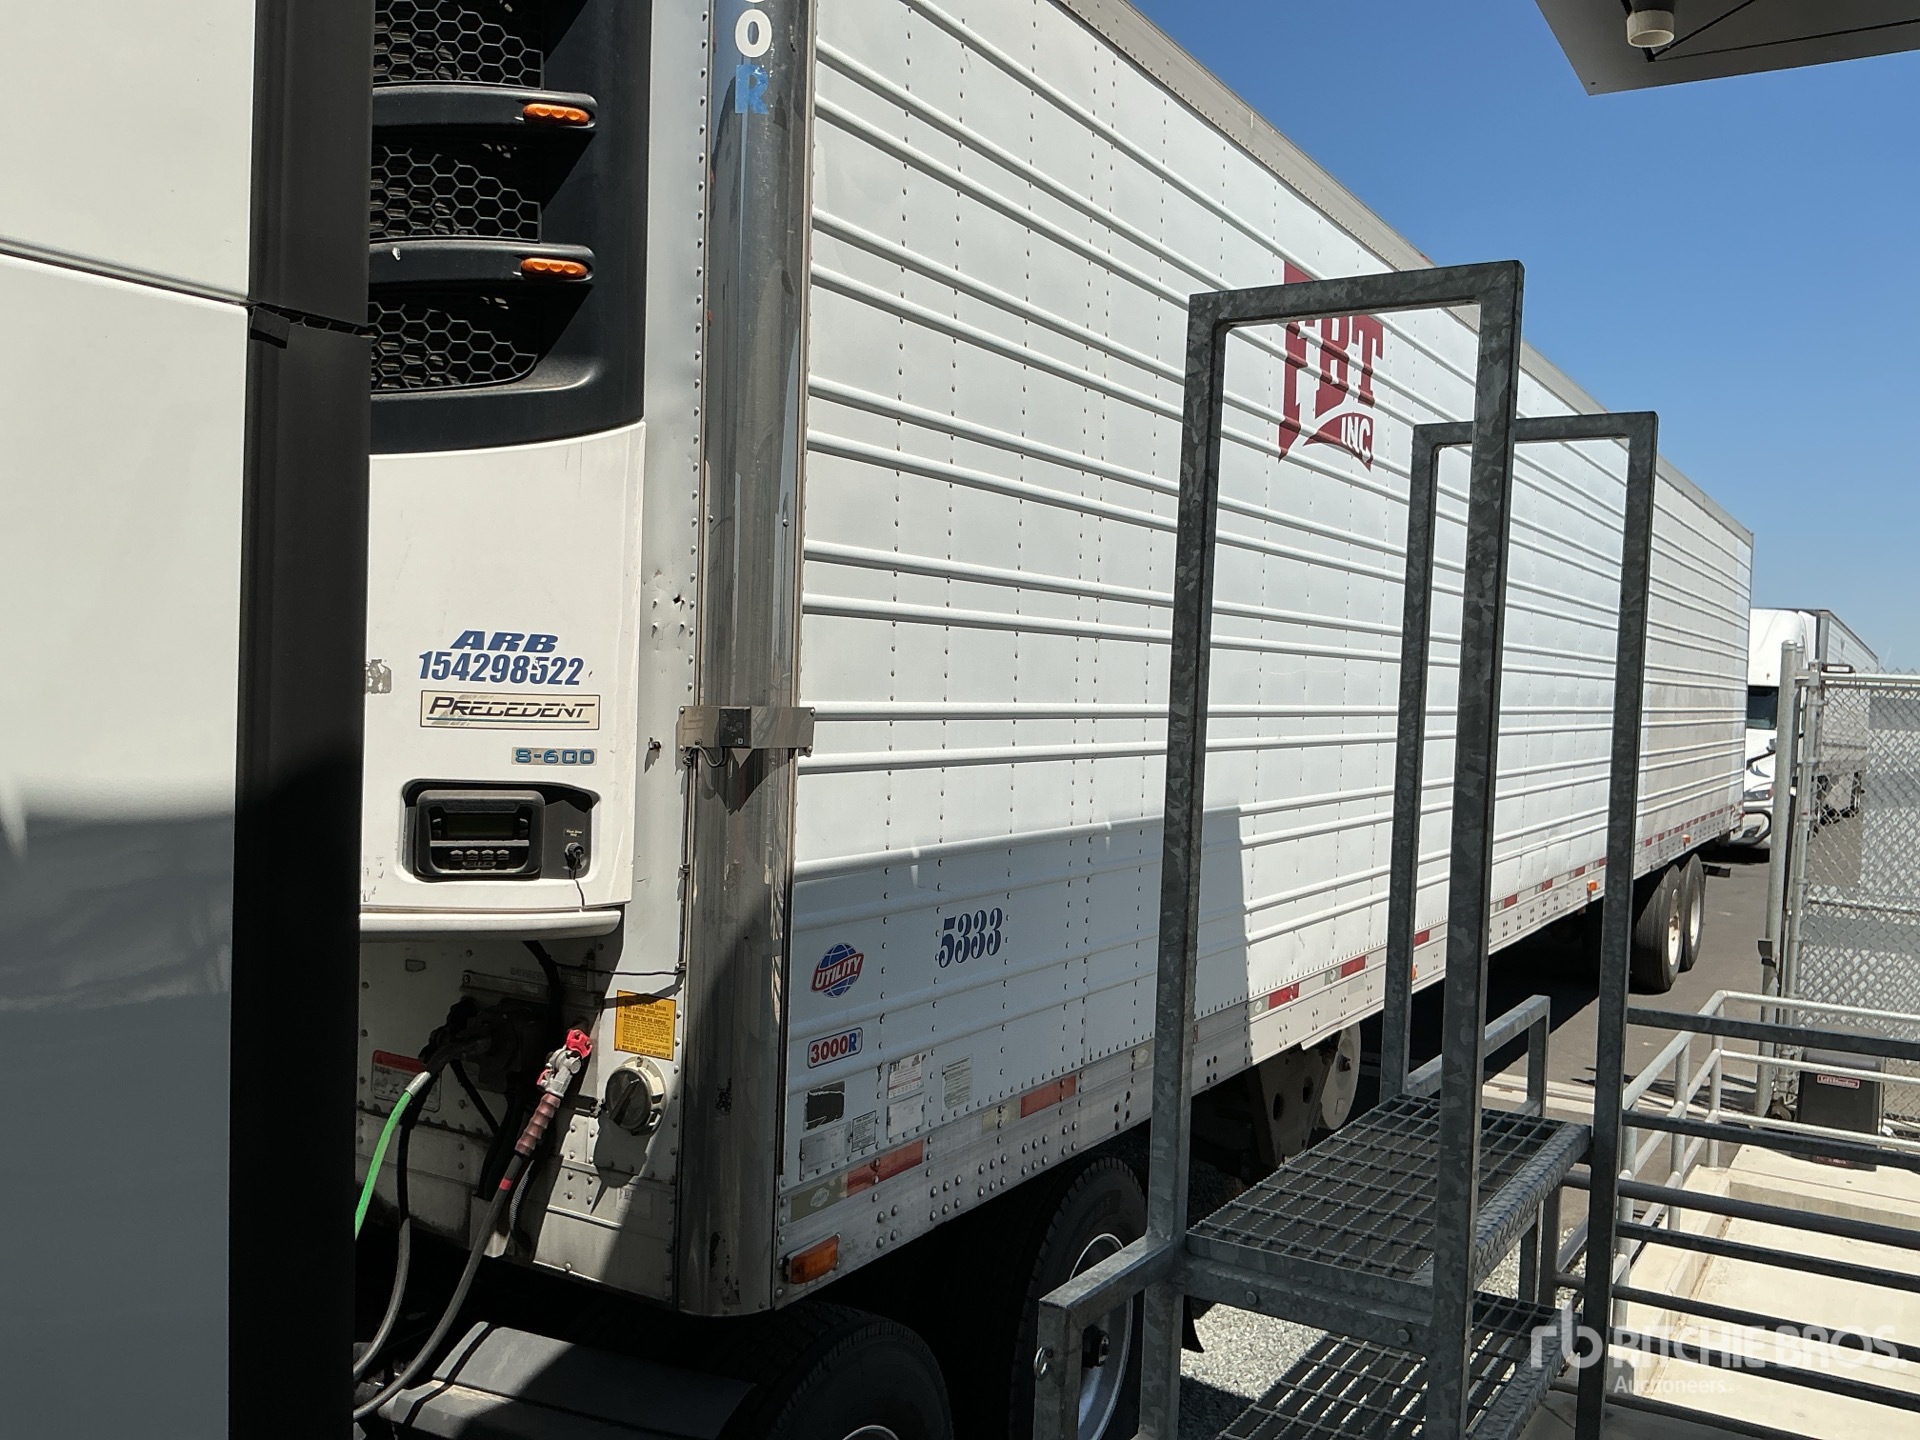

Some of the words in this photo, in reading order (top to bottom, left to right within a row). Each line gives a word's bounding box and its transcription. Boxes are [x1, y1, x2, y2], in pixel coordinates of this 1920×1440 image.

[1340, 415, 1372, 461] INC
[450, 629, 559, 653] ARB
[419, 651, 584, 685] 154298522
[515, 749, 595, 765] S-600
[938, 907, 1003, 969] 5333
[816, 957, 863, 989] UTILITY
